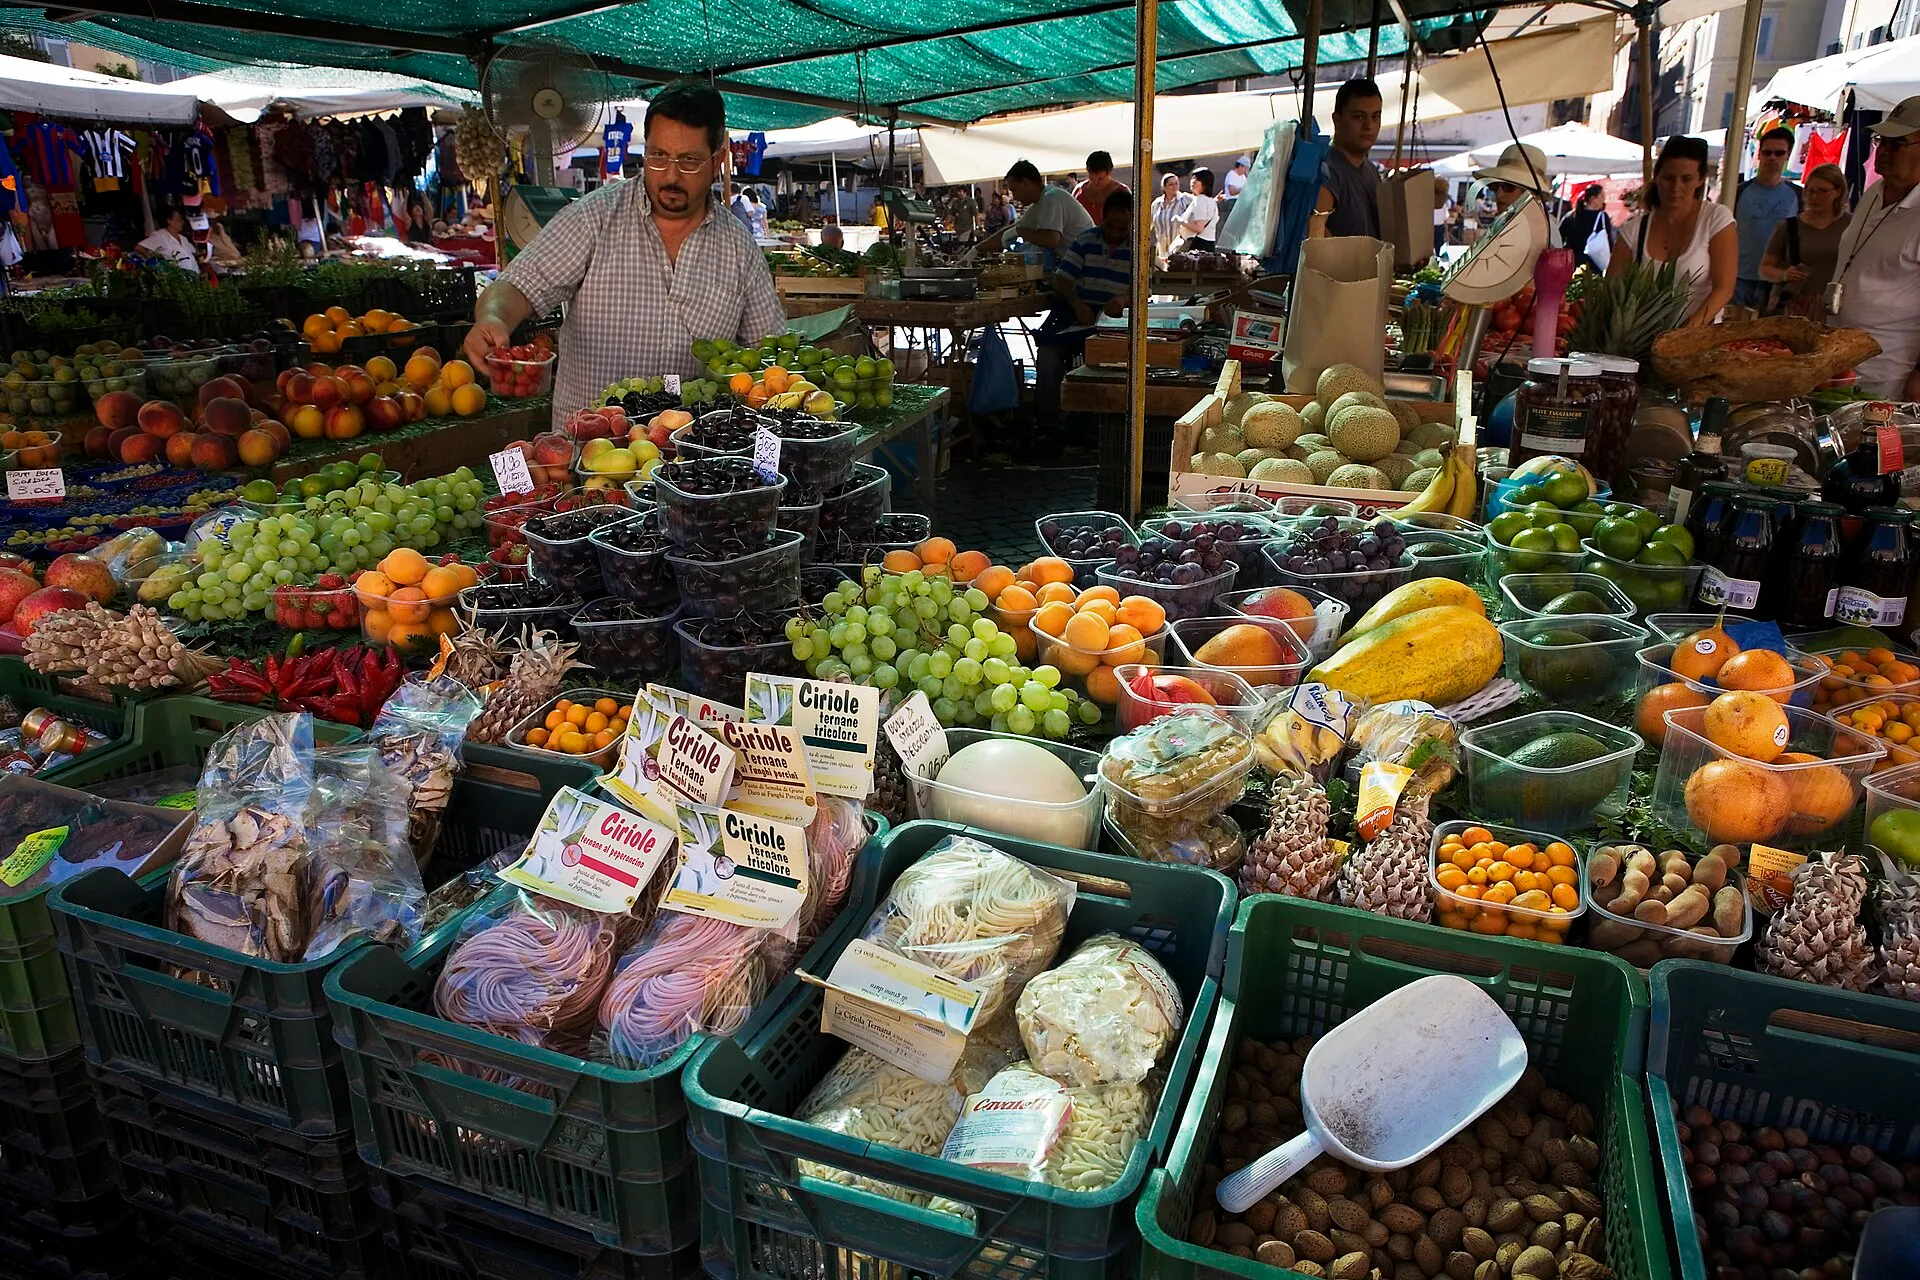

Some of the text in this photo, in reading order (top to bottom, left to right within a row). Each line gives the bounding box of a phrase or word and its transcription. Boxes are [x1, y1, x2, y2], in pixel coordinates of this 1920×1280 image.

[799, 681, 859, 714] Ciriole
[814, 724, 858, 741] tricolore
[819, 711, 859, 728] ternane
[668, 716, 721, 774] Ciriole
[723, 721, 793, 754] Ciriole
[902, 722, 941, 761] DECORATIVO
[669, 748, 704, 786] Ternane
[740, 748, 788, 769] Ternane
[740, 764, 799, 780] ai funghi porcini
[661, 765, 707, 802] ai funghi porcini
[767, 791, 785, 799] Funghi
[600, 812, 657, 854] Ciriole
[725, 813, 786, 851] Ciriole
[580, 834, 645, 869] ternane al peperoncino
[747, 855, 791, 876] tricolore
[749, 843, 789, 864] ternane
[869, 983, 884, 993] duro
[884, 988, 901, 999] grano
[834, 1006, 892, 1036] La Ciriola Ternana
